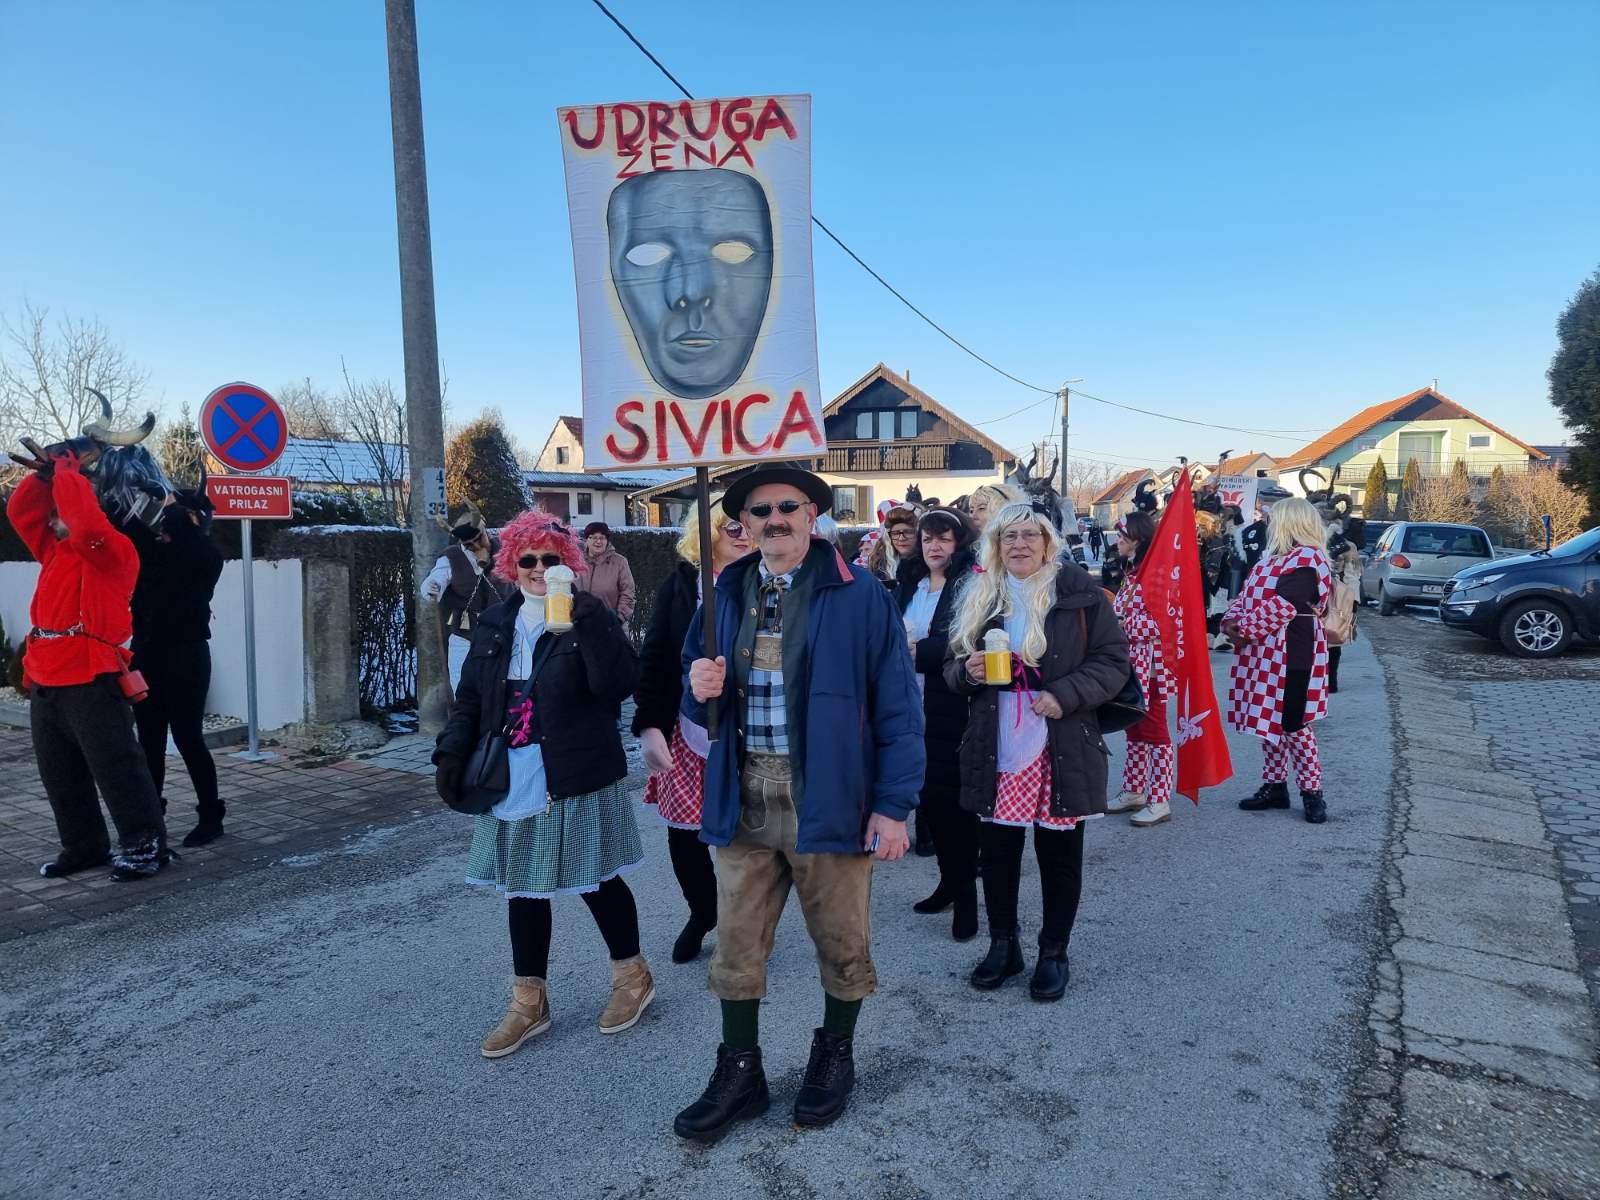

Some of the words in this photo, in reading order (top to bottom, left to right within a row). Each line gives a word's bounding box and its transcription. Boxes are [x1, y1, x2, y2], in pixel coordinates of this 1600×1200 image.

[565, 98, 798, 150] UDRUGA
[616, 138, 754, 179] ŽENA
[606, 391, 824, 463] SIVICA
[214, 484, 283, 496] VATROGASNI
[438, 486, 445, 499] 7
[229, 498, 269, 509] PRILAZ
[429, 502, 446, 516] 32
